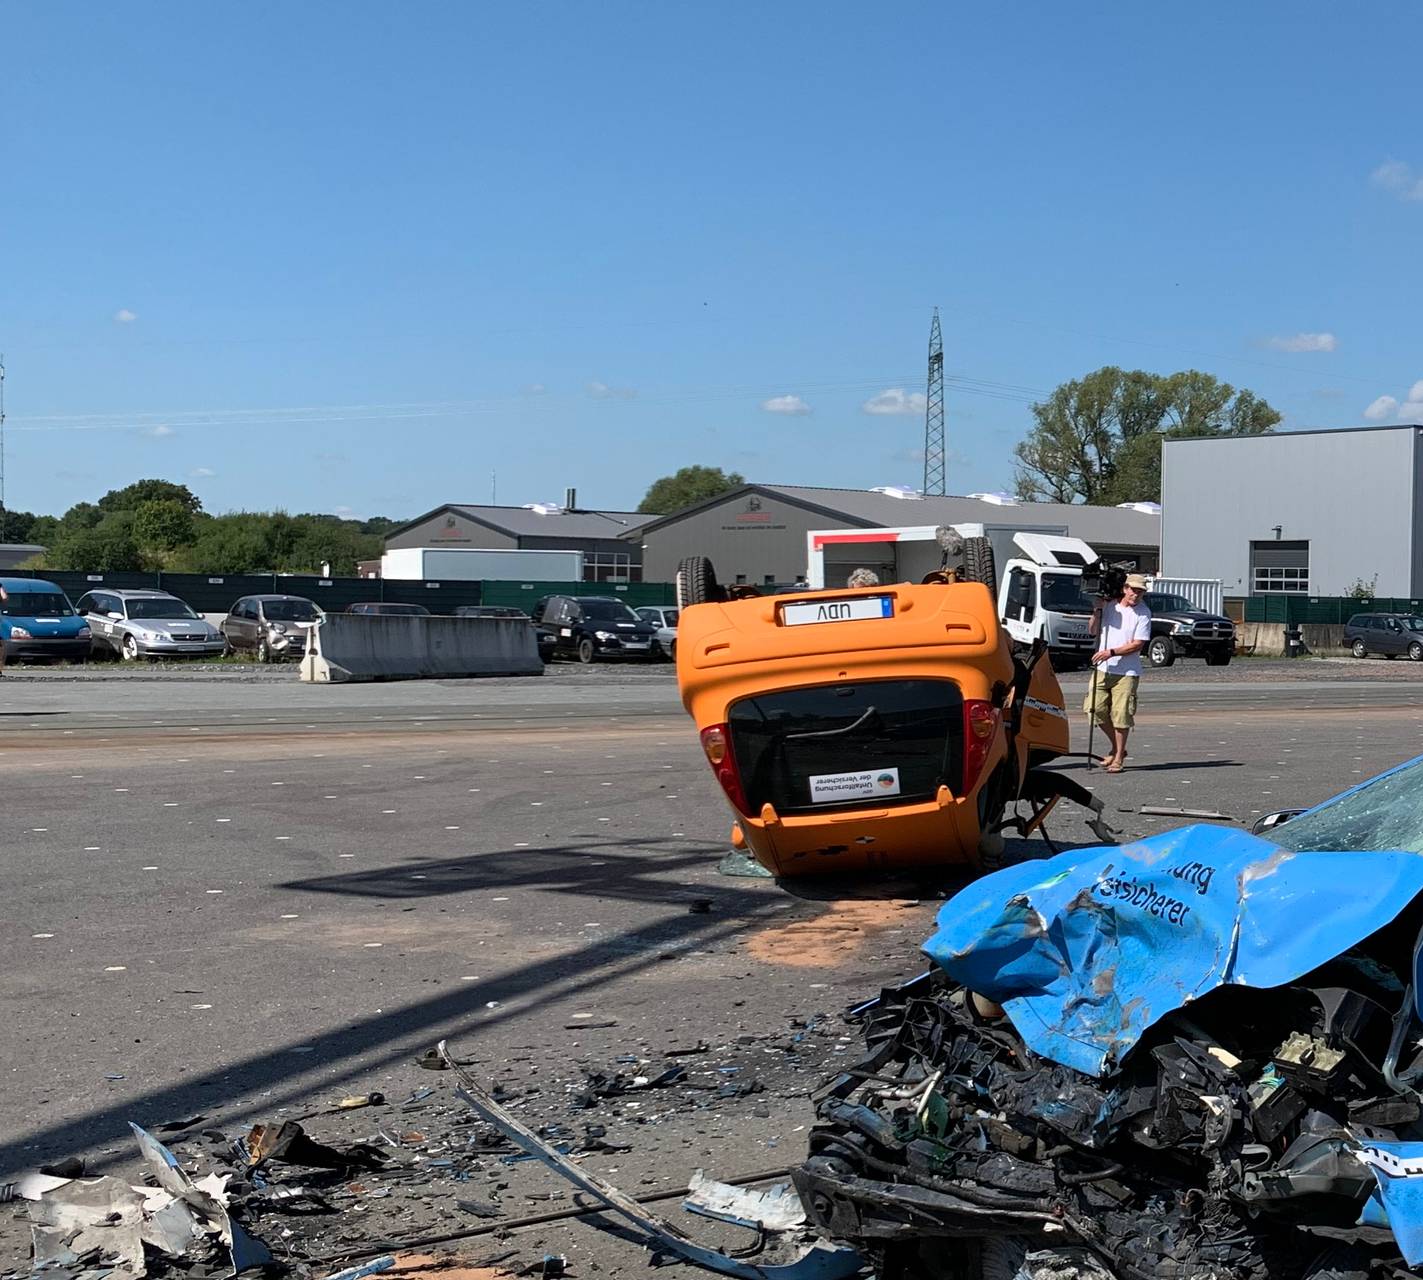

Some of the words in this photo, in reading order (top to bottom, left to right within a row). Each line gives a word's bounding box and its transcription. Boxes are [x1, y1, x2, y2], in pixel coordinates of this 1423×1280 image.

[817, 603, 851, 620] UDV
[816, 776, 857, 784] Versicherer
[815, 782, 872, 792] Unfallforschung
[1167, 861, 1216, 895] ung
